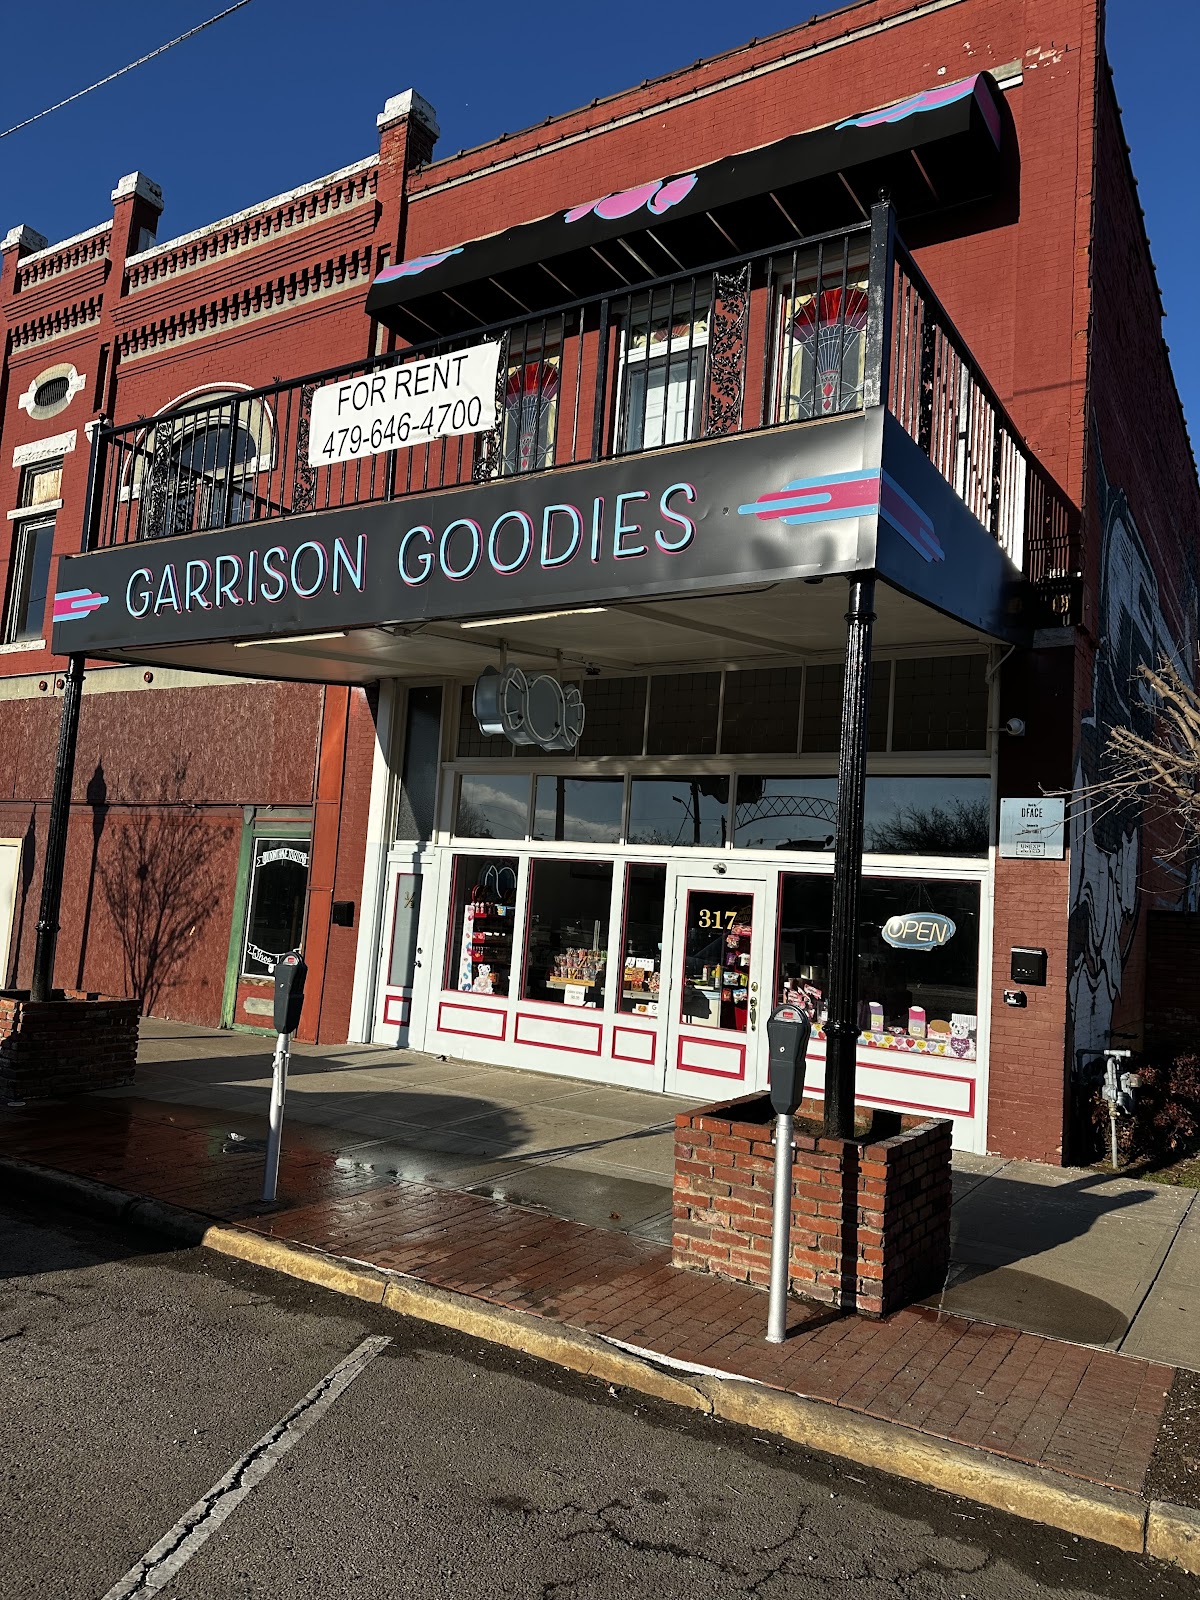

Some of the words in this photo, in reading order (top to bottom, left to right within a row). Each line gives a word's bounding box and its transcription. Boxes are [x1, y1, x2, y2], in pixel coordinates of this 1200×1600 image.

[338, 376, 386, 416] FOR
[394, 354, 469, 400] RENT
[322, 396, 482, 459] 479-646-4700
[126, 534, 368, 620] GARRISON
[398, 482, 698, 587] GOODIES
[698, 908, 738, 930] 317
[887, 918, 948, 942] OPEN
